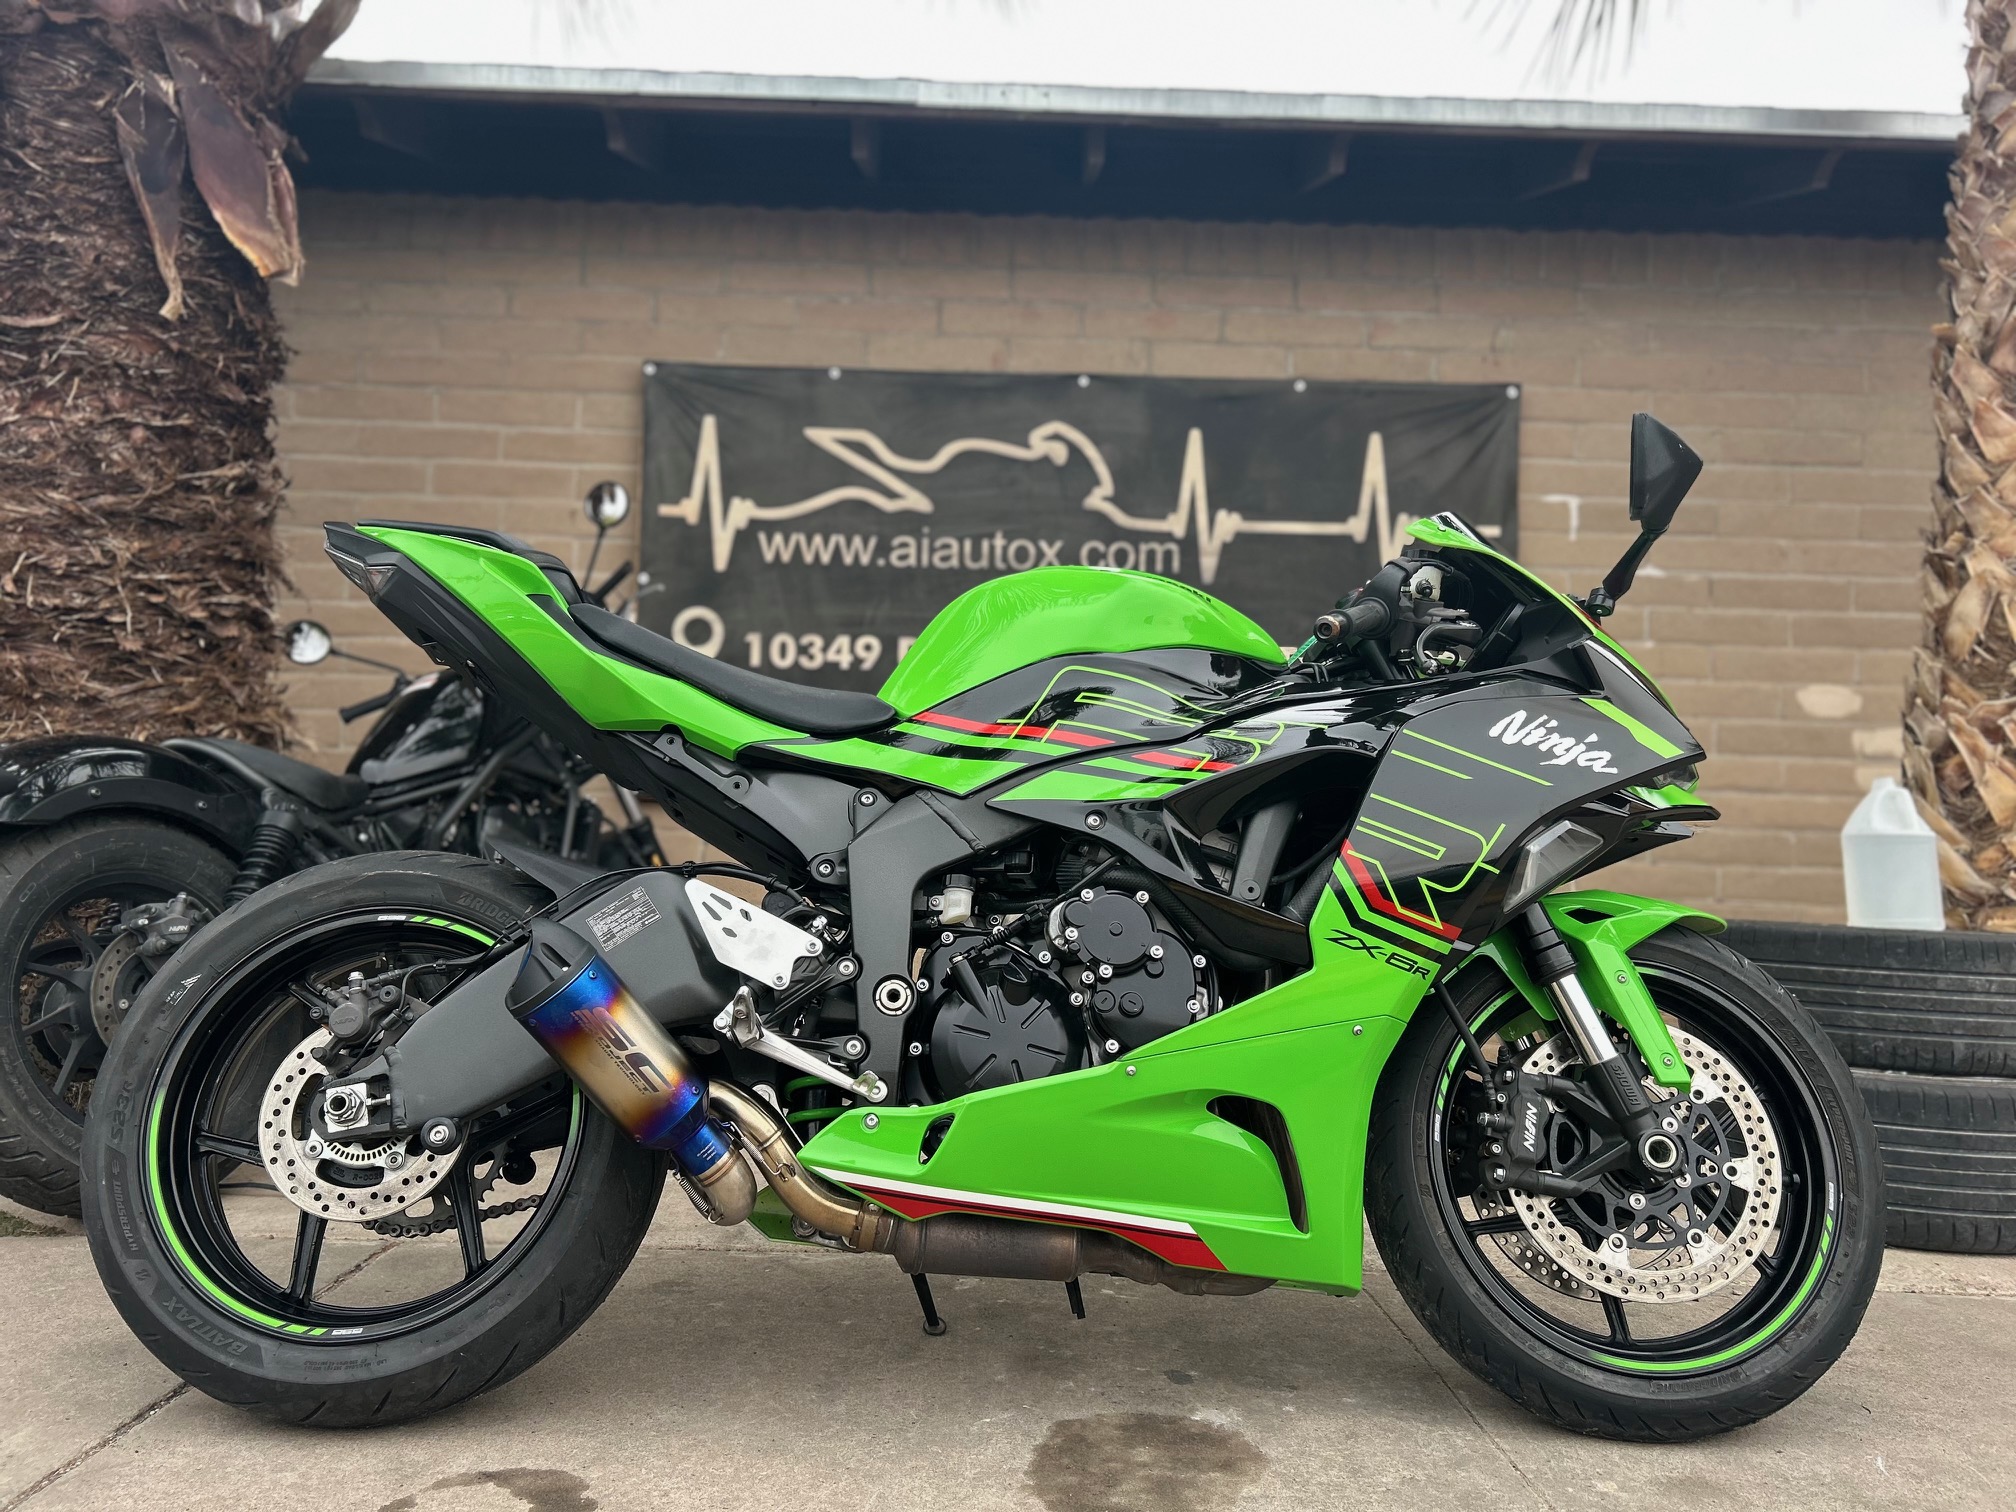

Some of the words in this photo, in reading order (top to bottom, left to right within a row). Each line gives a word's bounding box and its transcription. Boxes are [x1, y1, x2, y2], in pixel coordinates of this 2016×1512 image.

[757, 527, 1180, 573] www.aiautoxcom
[744, 631, 882, 671] 10349
[1488, 709, 1618, 774] Ninja
[1324, 929, 1431, 982] ZX-6R
[1609, 1063, 1642, 1107] SHOWA
[113, 1180, 139, 1252] HYPERSPORT
[162, 1296, 249, 1356] BATTLAX
